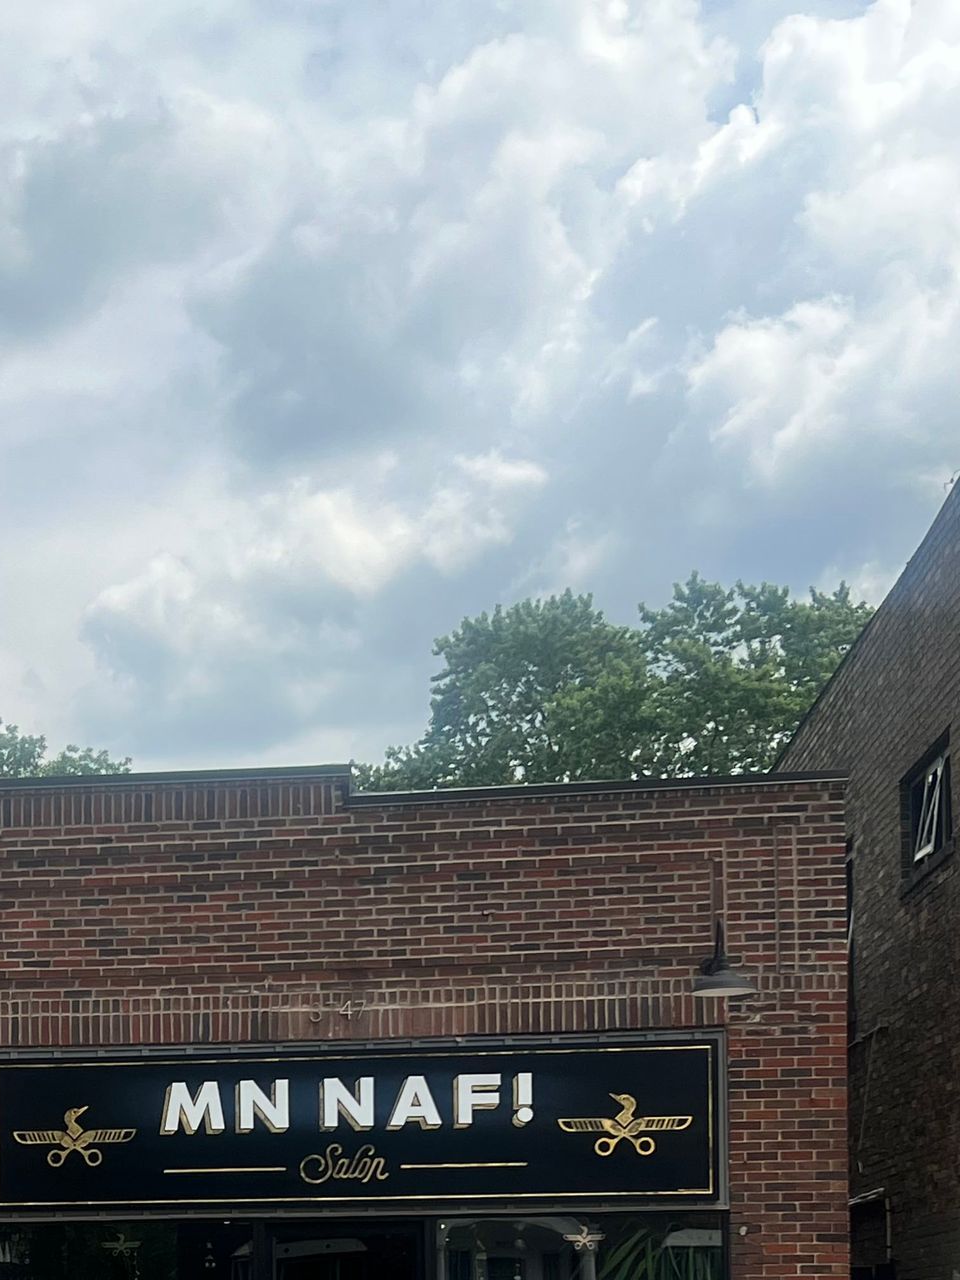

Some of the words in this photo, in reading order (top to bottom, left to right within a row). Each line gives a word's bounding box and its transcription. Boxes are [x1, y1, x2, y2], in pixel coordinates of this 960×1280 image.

[160, 1079, 289, 1135] MN
[319, 1072, 534, 1132] NAF!
[299, 1143, 389, 1184] Salon
